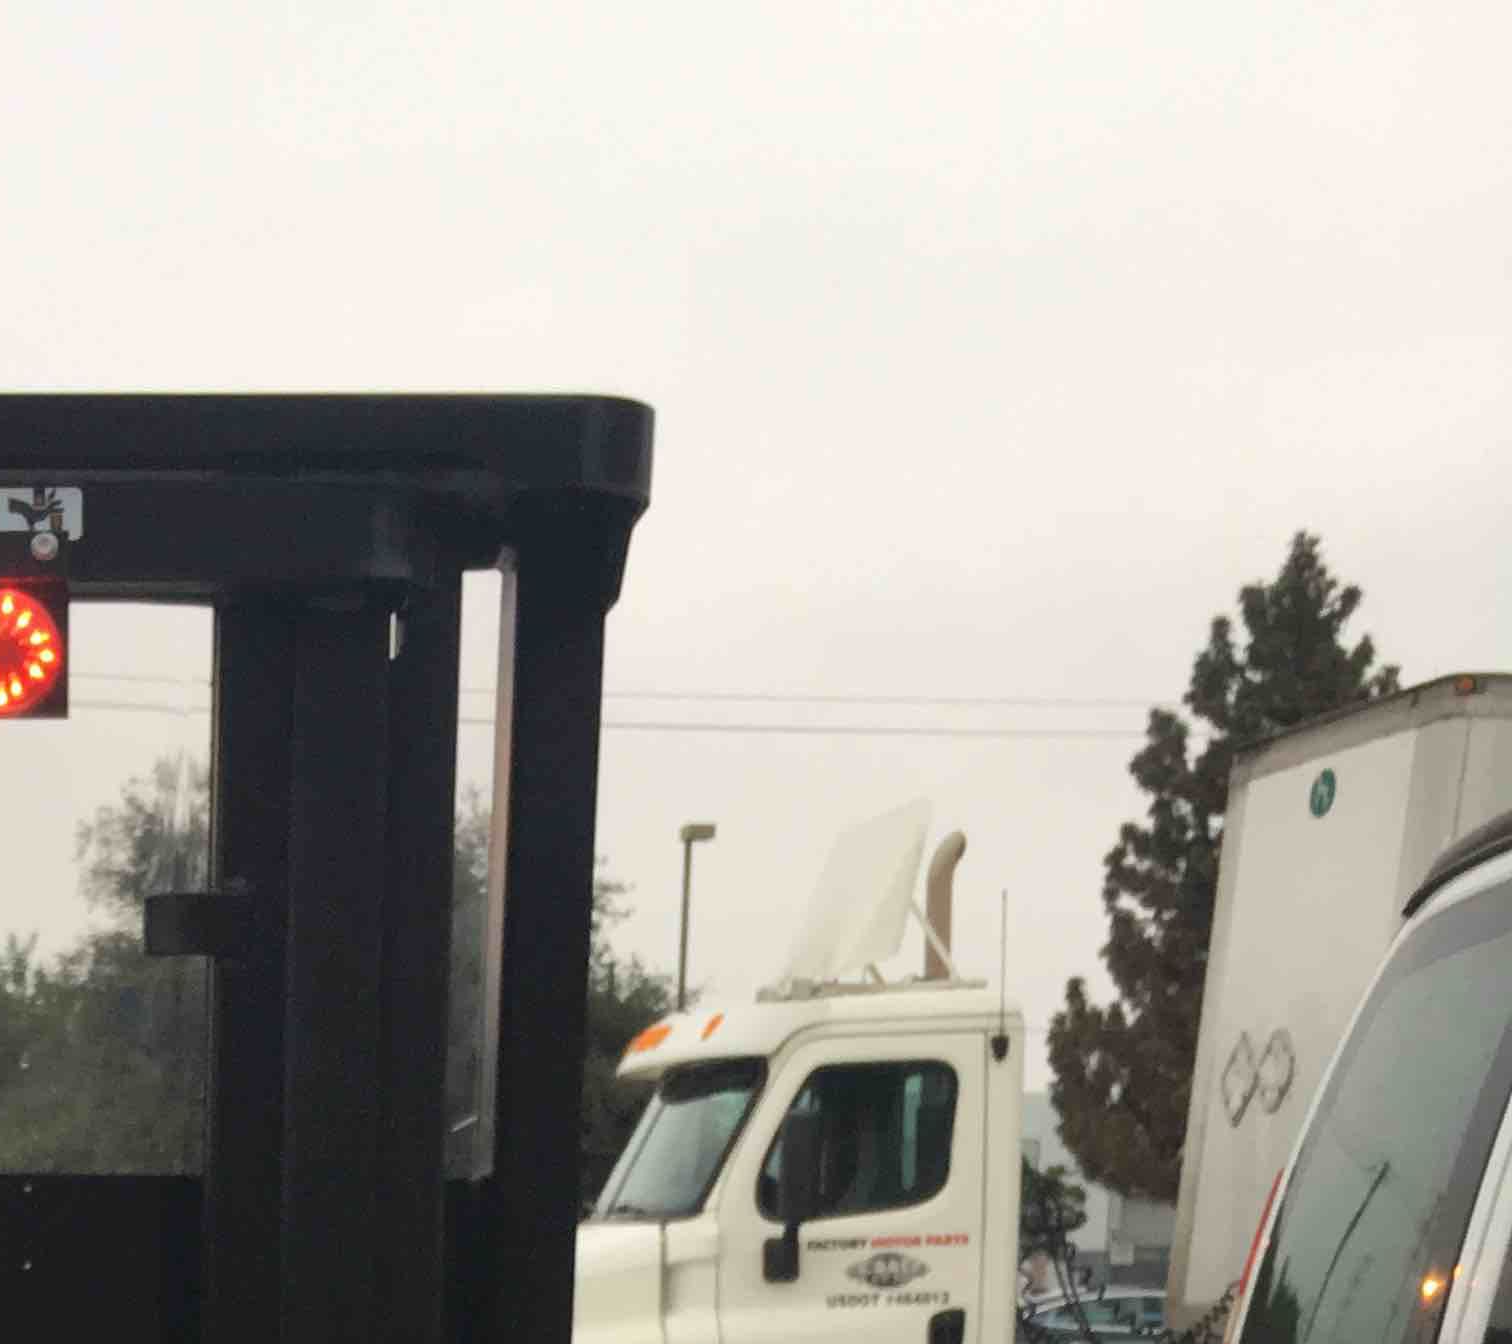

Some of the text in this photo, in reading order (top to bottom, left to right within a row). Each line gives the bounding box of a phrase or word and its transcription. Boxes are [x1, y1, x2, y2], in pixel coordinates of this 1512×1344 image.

[807, 1232, 969, 1250] FACTORY MOTOR PARTS
[826, 1293, 879, 1309] USDOT
